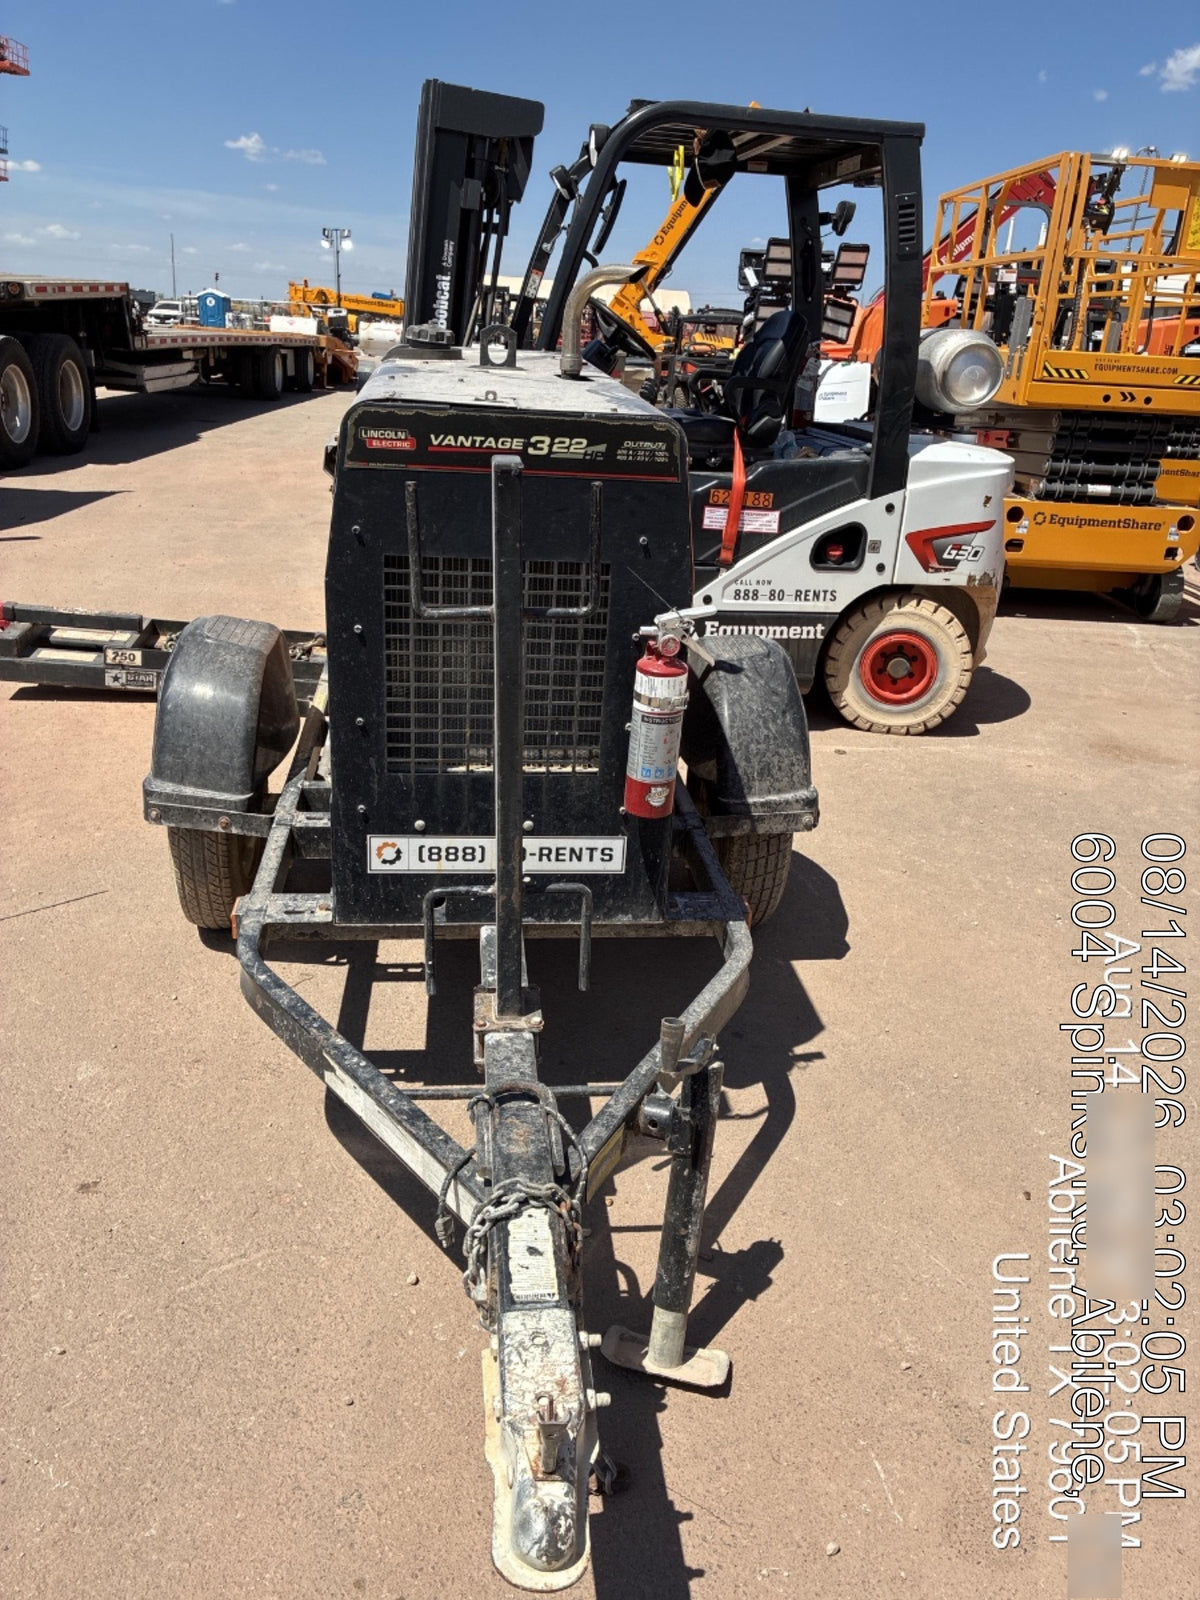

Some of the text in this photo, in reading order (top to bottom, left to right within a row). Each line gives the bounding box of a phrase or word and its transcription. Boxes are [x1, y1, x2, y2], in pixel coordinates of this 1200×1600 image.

[1094, 363, 1178, 375] EQUIPMENTSHARE.COM
[361, 429, 406, 439] LINCOLN
[372, 440, 411, 448] ELECTRIC
[429, 433, 524, 450] VANTAGE
[527, 435, 588, 456] 322
[711, 490, 772, 507] 6288
[1048, 513, 1162, 532] EquipmentShare
[942, 544, 985, 561] G30
[733, 588, 837, 602] 888-80-RENTS
[111, 651, 136, 662] 250
[418, 845, 614, 863] (888) -RENTS
